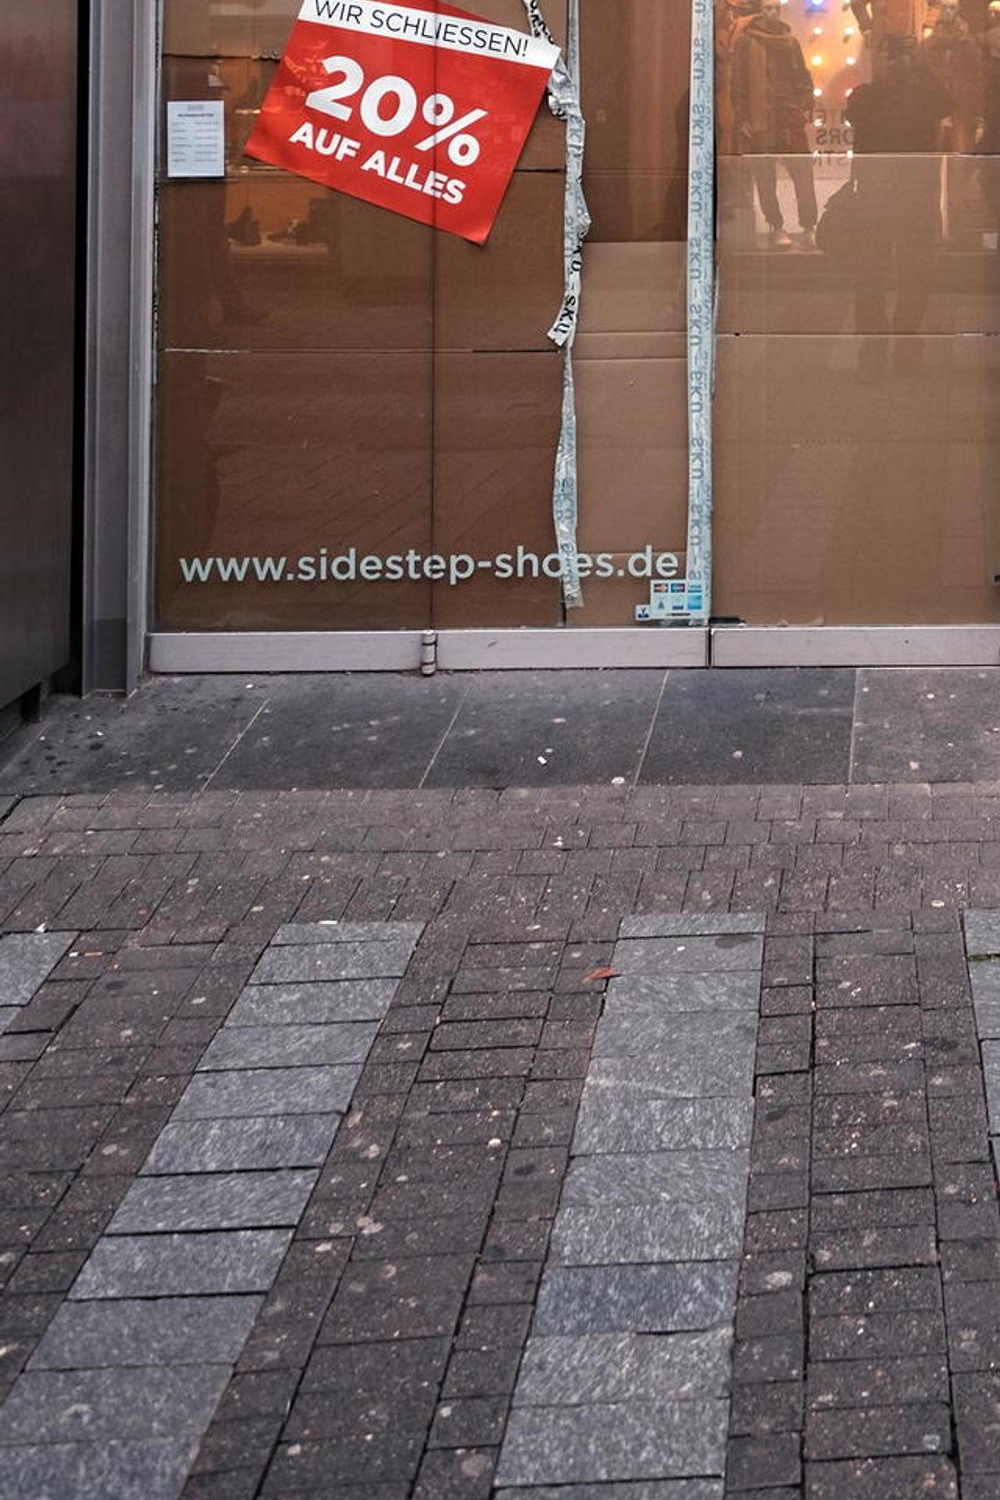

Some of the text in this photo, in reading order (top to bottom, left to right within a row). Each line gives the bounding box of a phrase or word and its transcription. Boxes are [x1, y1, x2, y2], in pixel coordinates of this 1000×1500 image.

[369, 9, 529, 58] SCHLIESSEN!
[305, 55, 488, 167] 20%
[289, 122, 467, 205] AUF ALLES
[179, 545, 679, 586] www.sidestep-shoes.de
